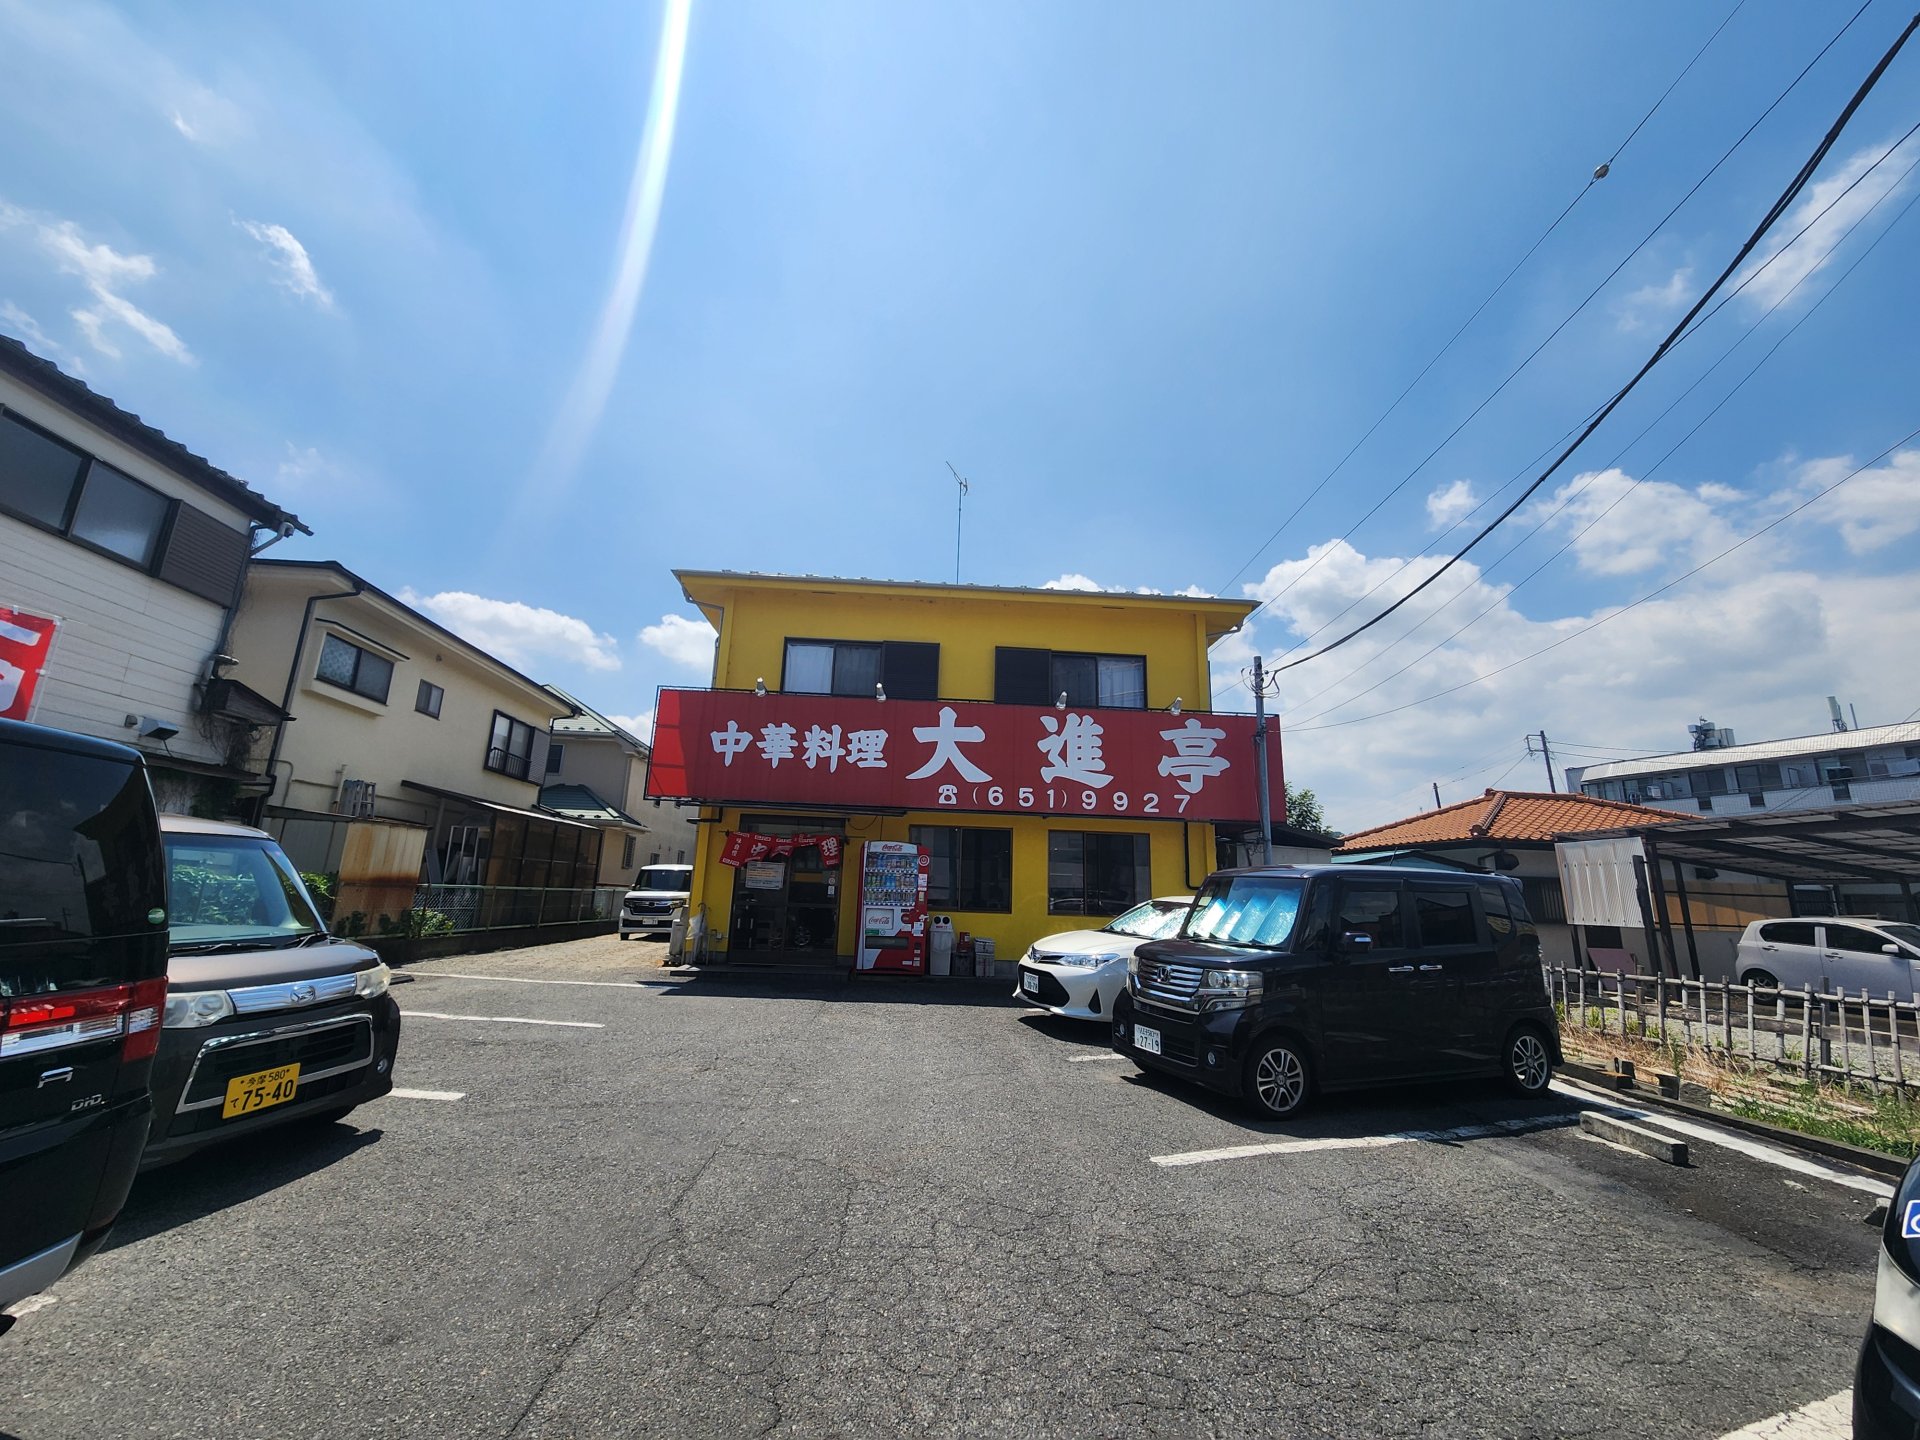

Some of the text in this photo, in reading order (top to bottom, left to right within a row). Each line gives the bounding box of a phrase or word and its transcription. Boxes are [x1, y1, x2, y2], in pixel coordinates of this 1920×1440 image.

[710, 706, 1231, 794] 中華料理 大進亭
[268, 1069, 286, 1083] 580
[241, 1079, 294, 1111] 75-40
